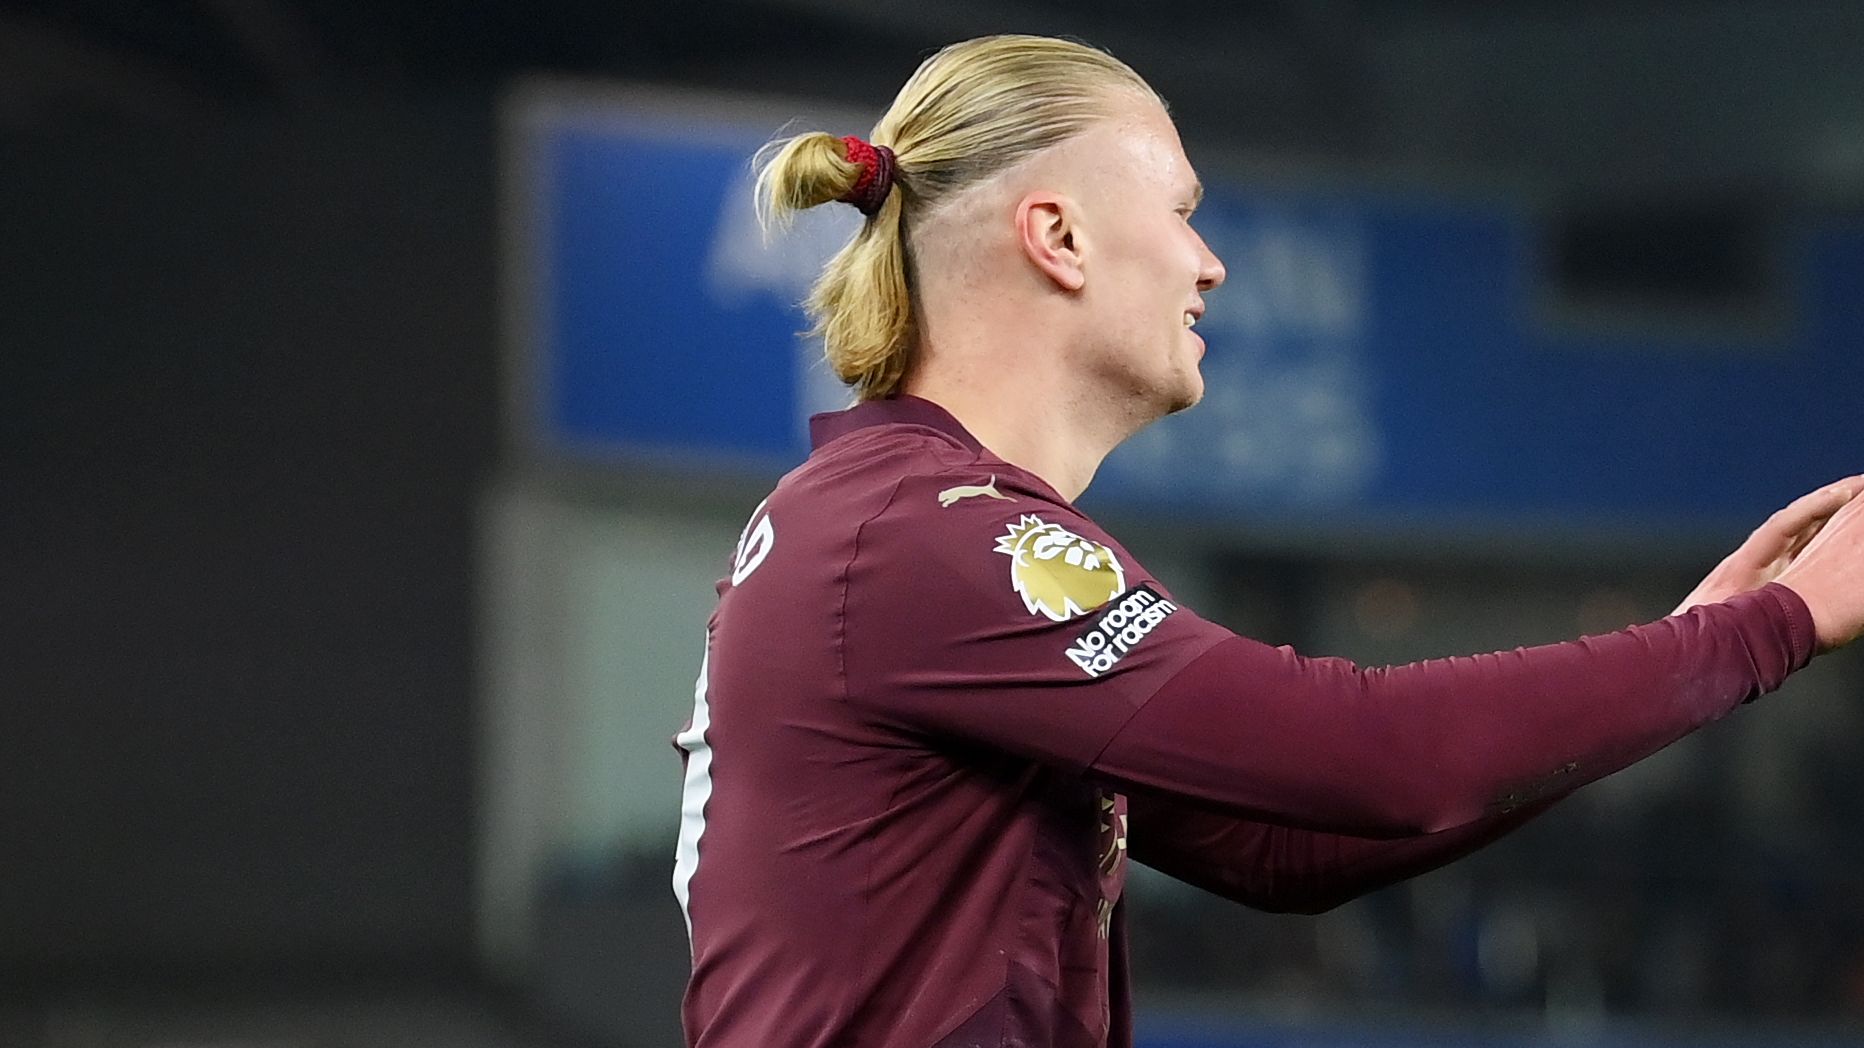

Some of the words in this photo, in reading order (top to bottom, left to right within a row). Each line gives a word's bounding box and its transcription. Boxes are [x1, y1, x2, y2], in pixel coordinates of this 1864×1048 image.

[1065, 630, 1106, 669] No
[1099, 590, 1156, 635] room
[1083, 643, 1121, 678] for
[1112, 599, 1177, 653] racism
